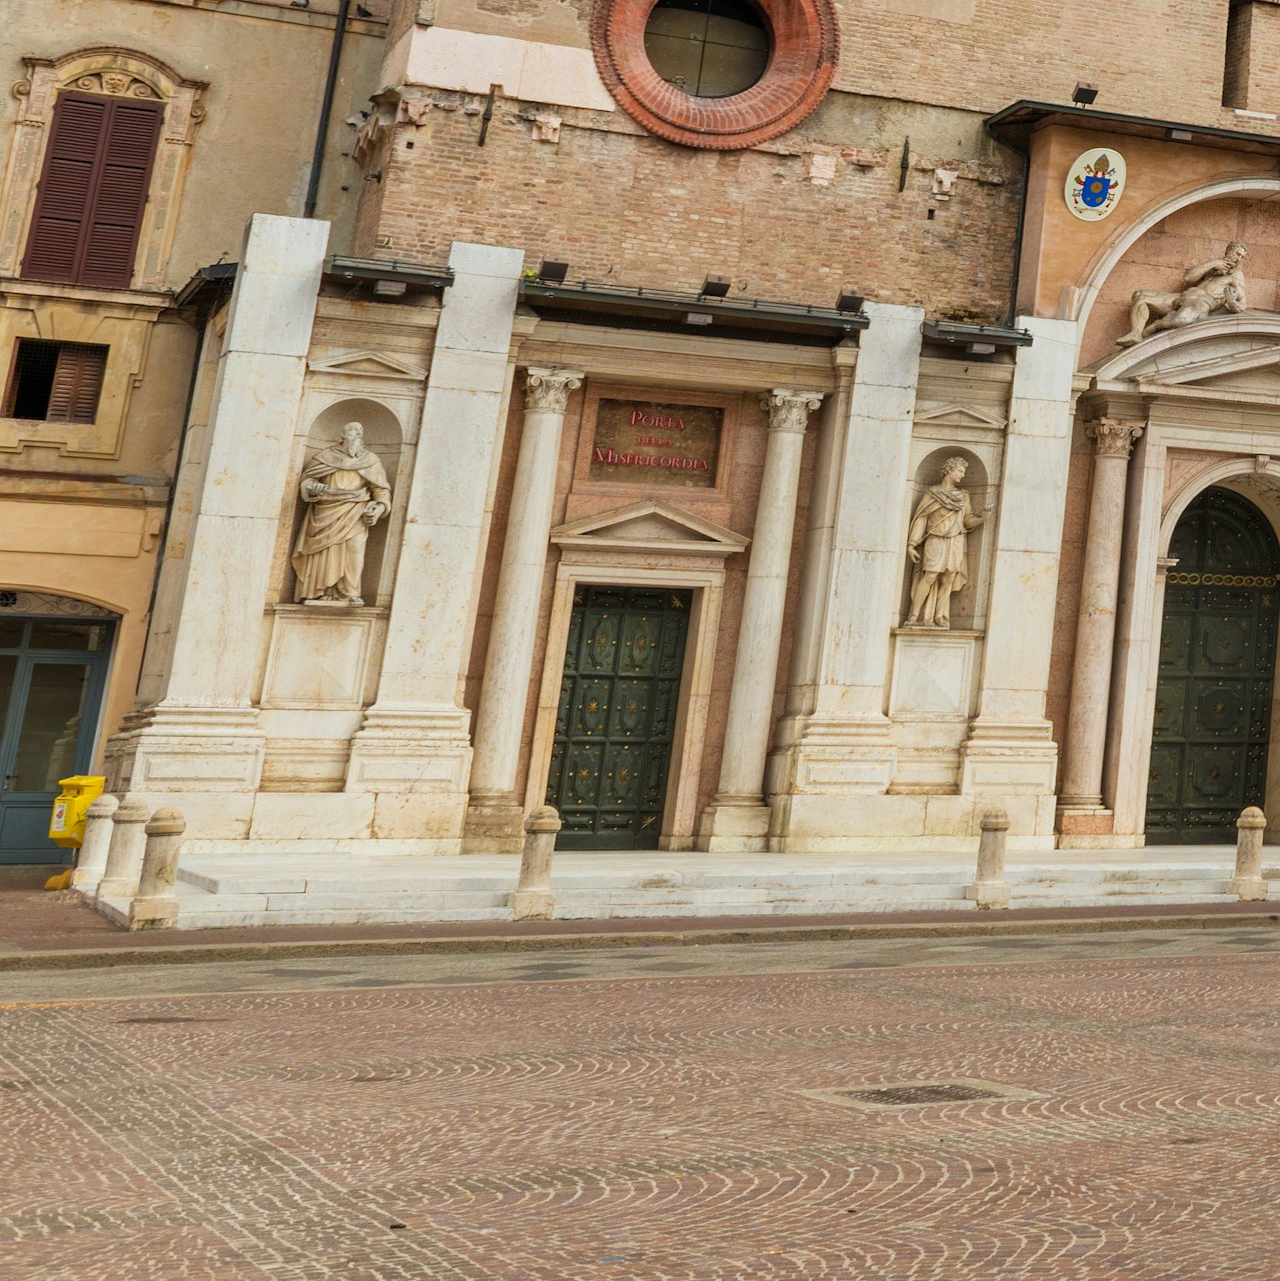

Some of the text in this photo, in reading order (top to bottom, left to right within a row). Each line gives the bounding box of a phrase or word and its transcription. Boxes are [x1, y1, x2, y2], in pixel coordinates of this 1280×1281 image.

[631, 409, 686, 430] PORTA
[636, 435, 673, 447] DELLA
[593, 448, 708, 470] MISERICORDIA
